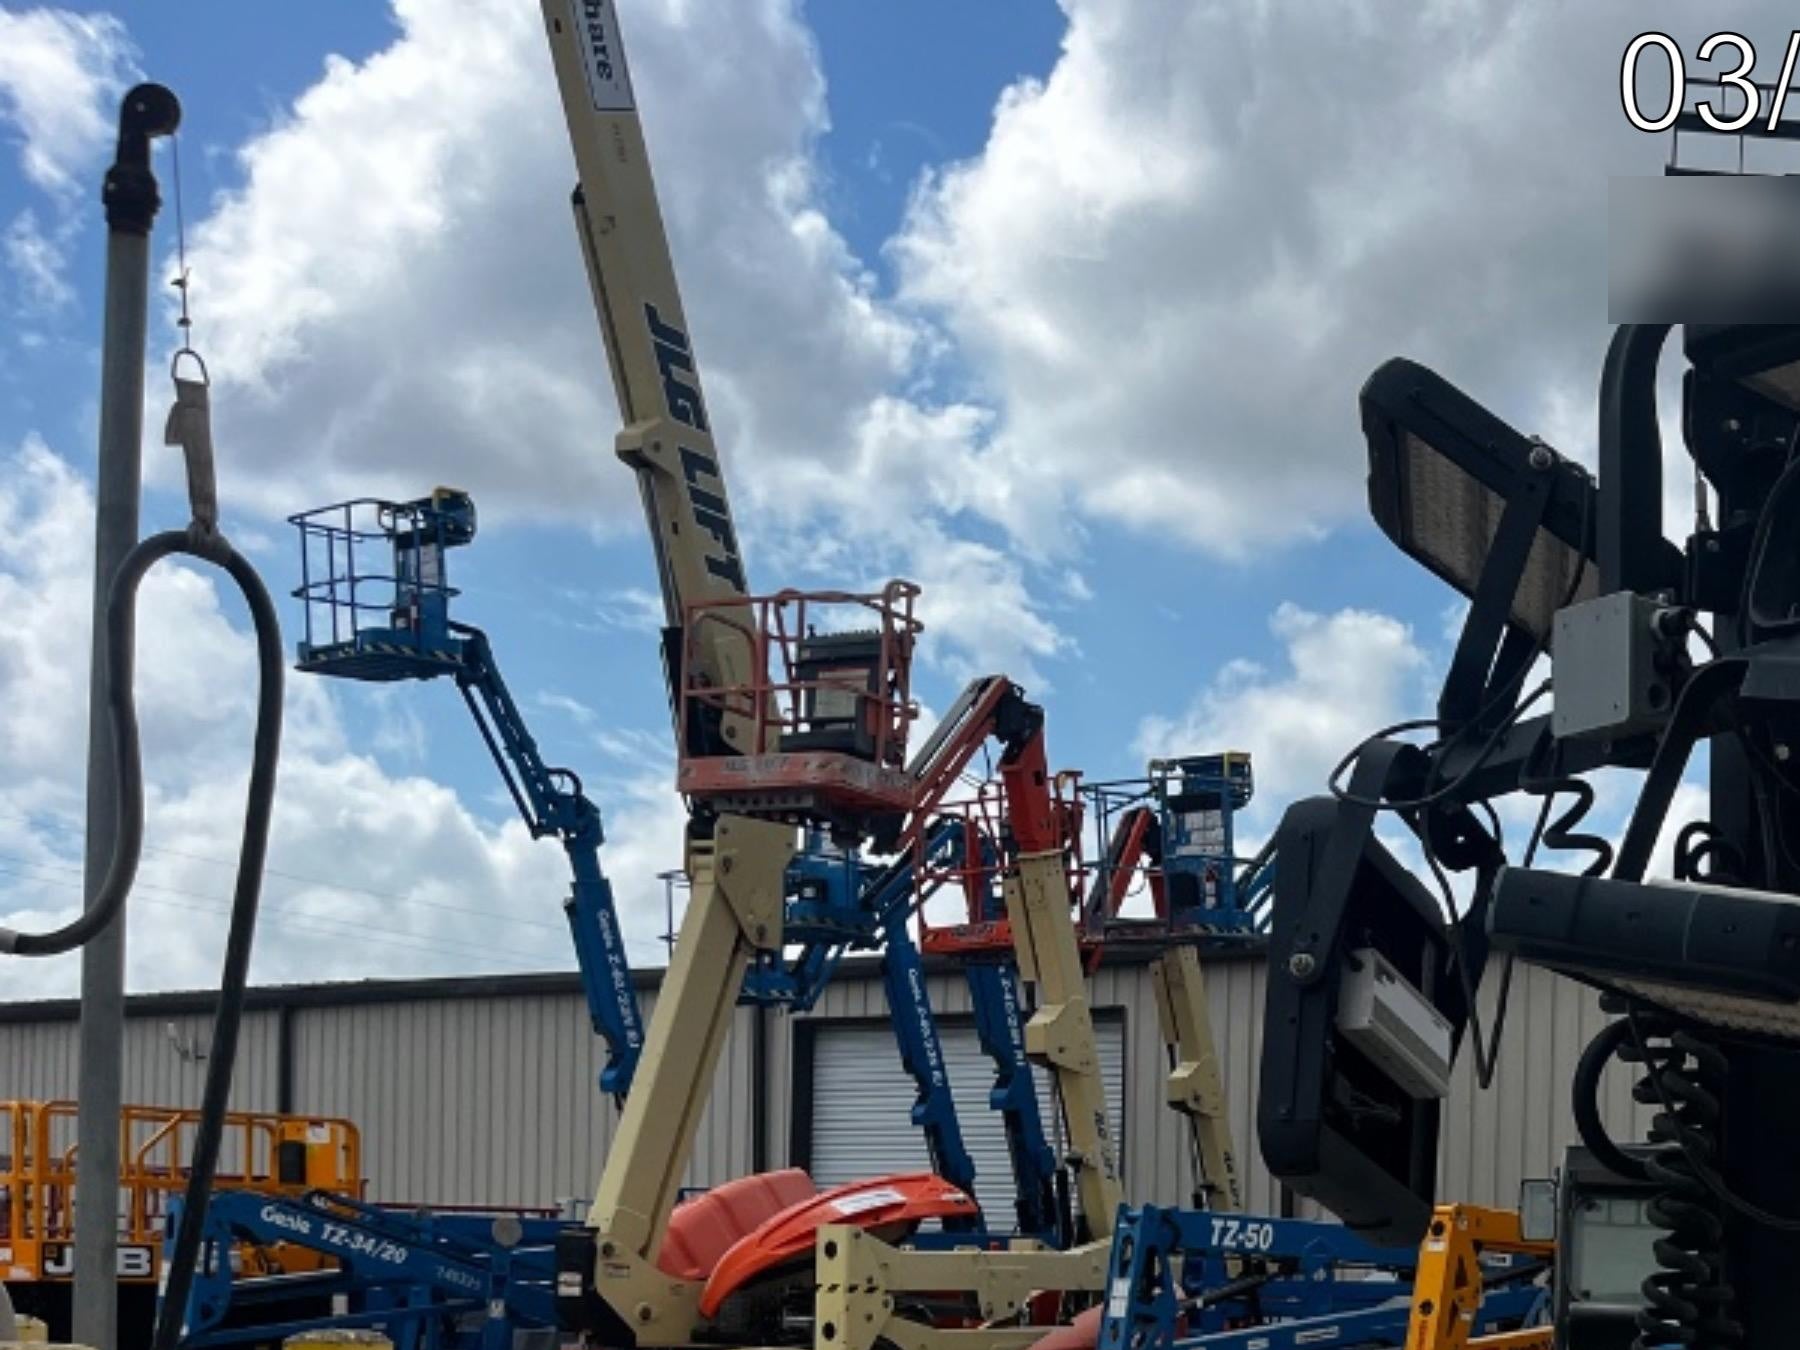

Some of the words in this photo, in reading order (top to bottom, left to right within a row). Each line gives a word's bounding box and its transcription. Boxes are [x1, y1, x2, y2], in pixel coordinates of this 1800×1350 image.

[644, 302, 708, 432] JLG
[678, 447, 746, 593] LIFT
[260, 1205, 312, 1235] Genie
[320, 1223, 408, 1265] TZ-34/20
[1211, 1218, 1274, 1252] TZ-50
[44, 1247, 151, 1276] JB
